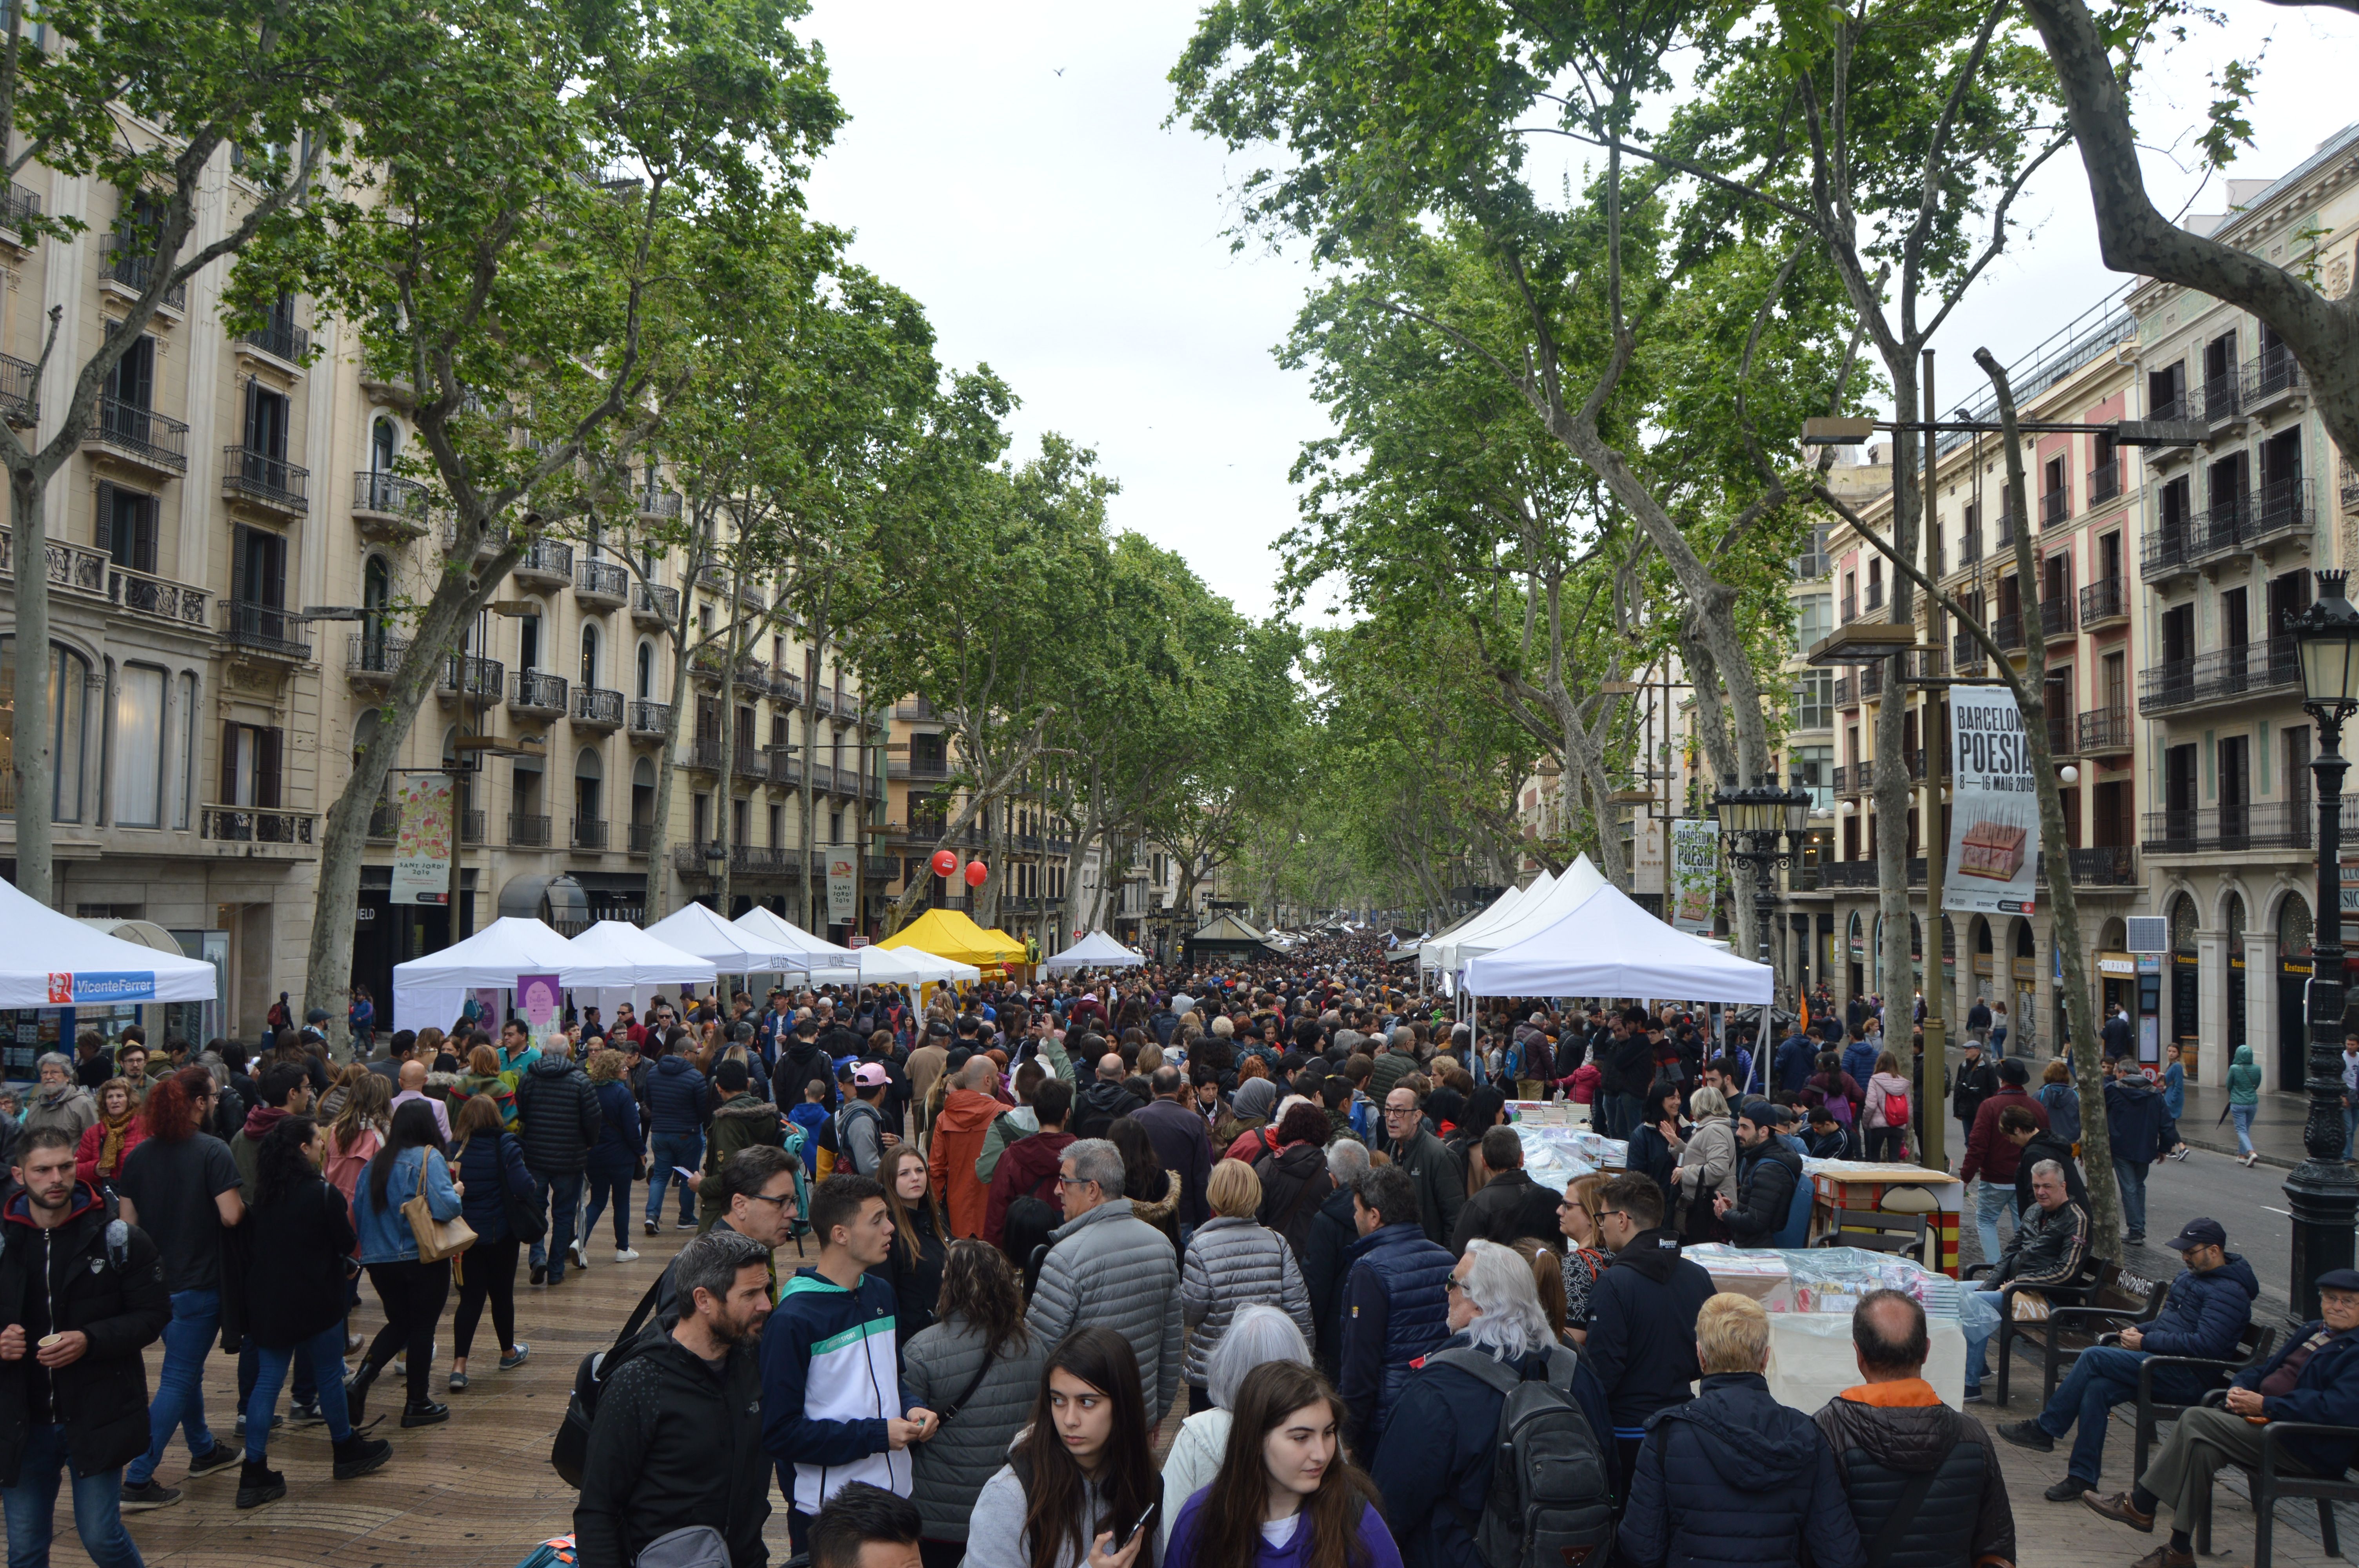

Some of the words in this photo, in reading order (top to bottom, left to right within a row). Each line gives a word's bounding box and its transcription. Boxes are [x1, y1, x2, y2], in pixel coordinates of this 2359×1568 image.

[1957, 706, 2024, 732] BARCELON
[1993, 776, 2013, 791] MAIG
[2016, 777, 2034, 792] 2019
[357, 908, 375, 920] IELD
[77, 979, 152, 993] VicenteFerrer
[841, 1332, 856, 1342] SPORT
